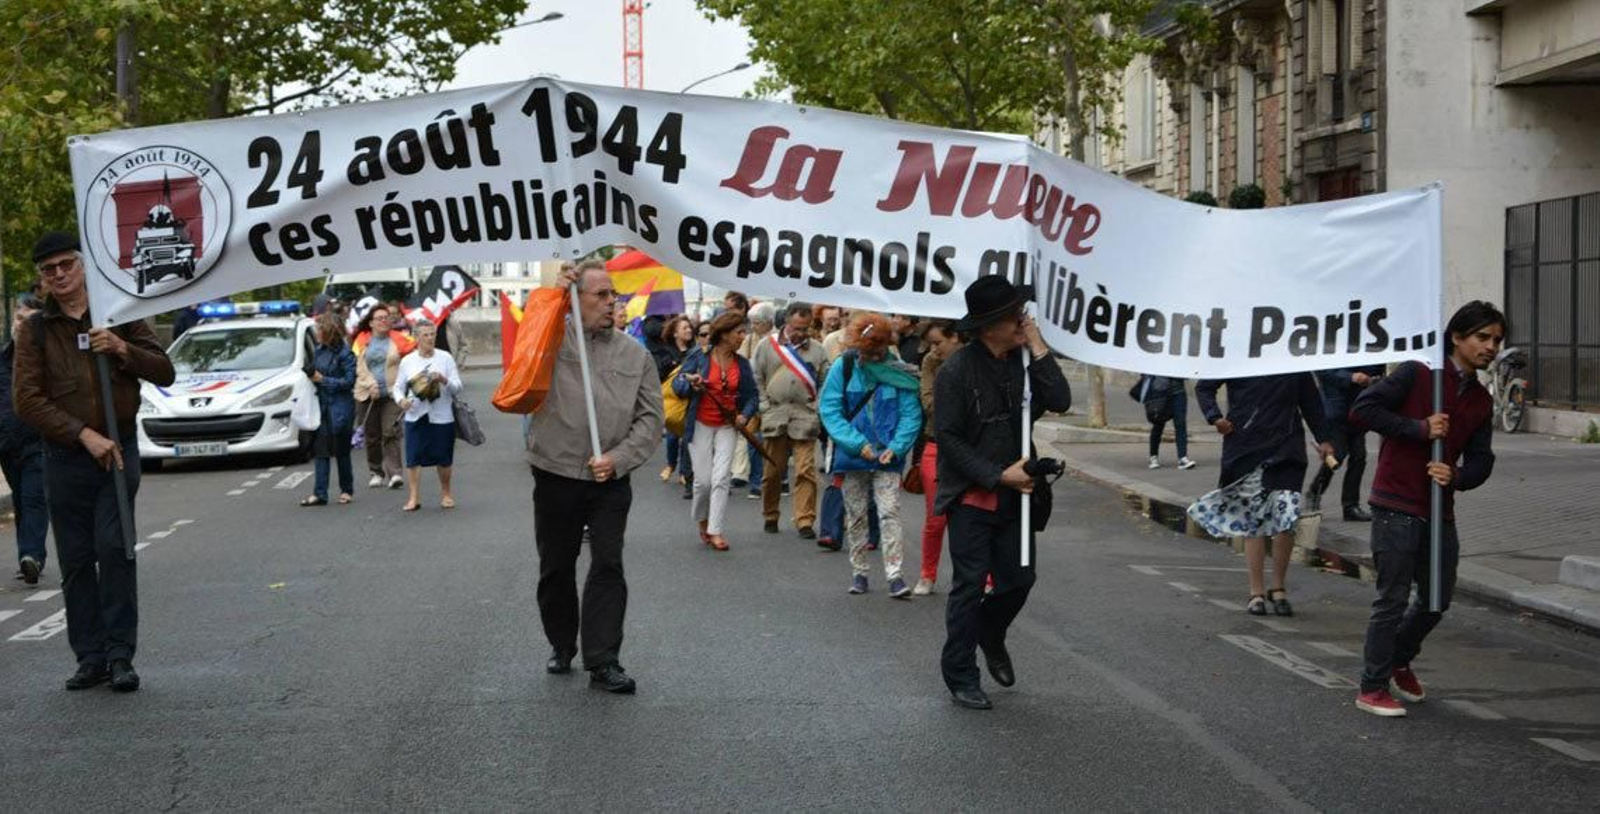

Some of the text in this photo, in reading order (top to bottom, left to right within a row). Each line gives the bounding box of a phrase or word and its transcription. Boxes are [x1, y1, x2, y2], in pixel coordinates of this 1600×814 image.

[100, 168, 118, 188] 24
[174, 151, 211, 178] 1944
[247, 87, 687, 209] 24 août 1944
[720, 125, 1102, 256] La Nueve
[248, 214, 340, 266] ces
[355, 170, 659, 252] républicains
[678, 215, 956, 295] espagnols
[1044, 260, 1228, 359] libèrent
